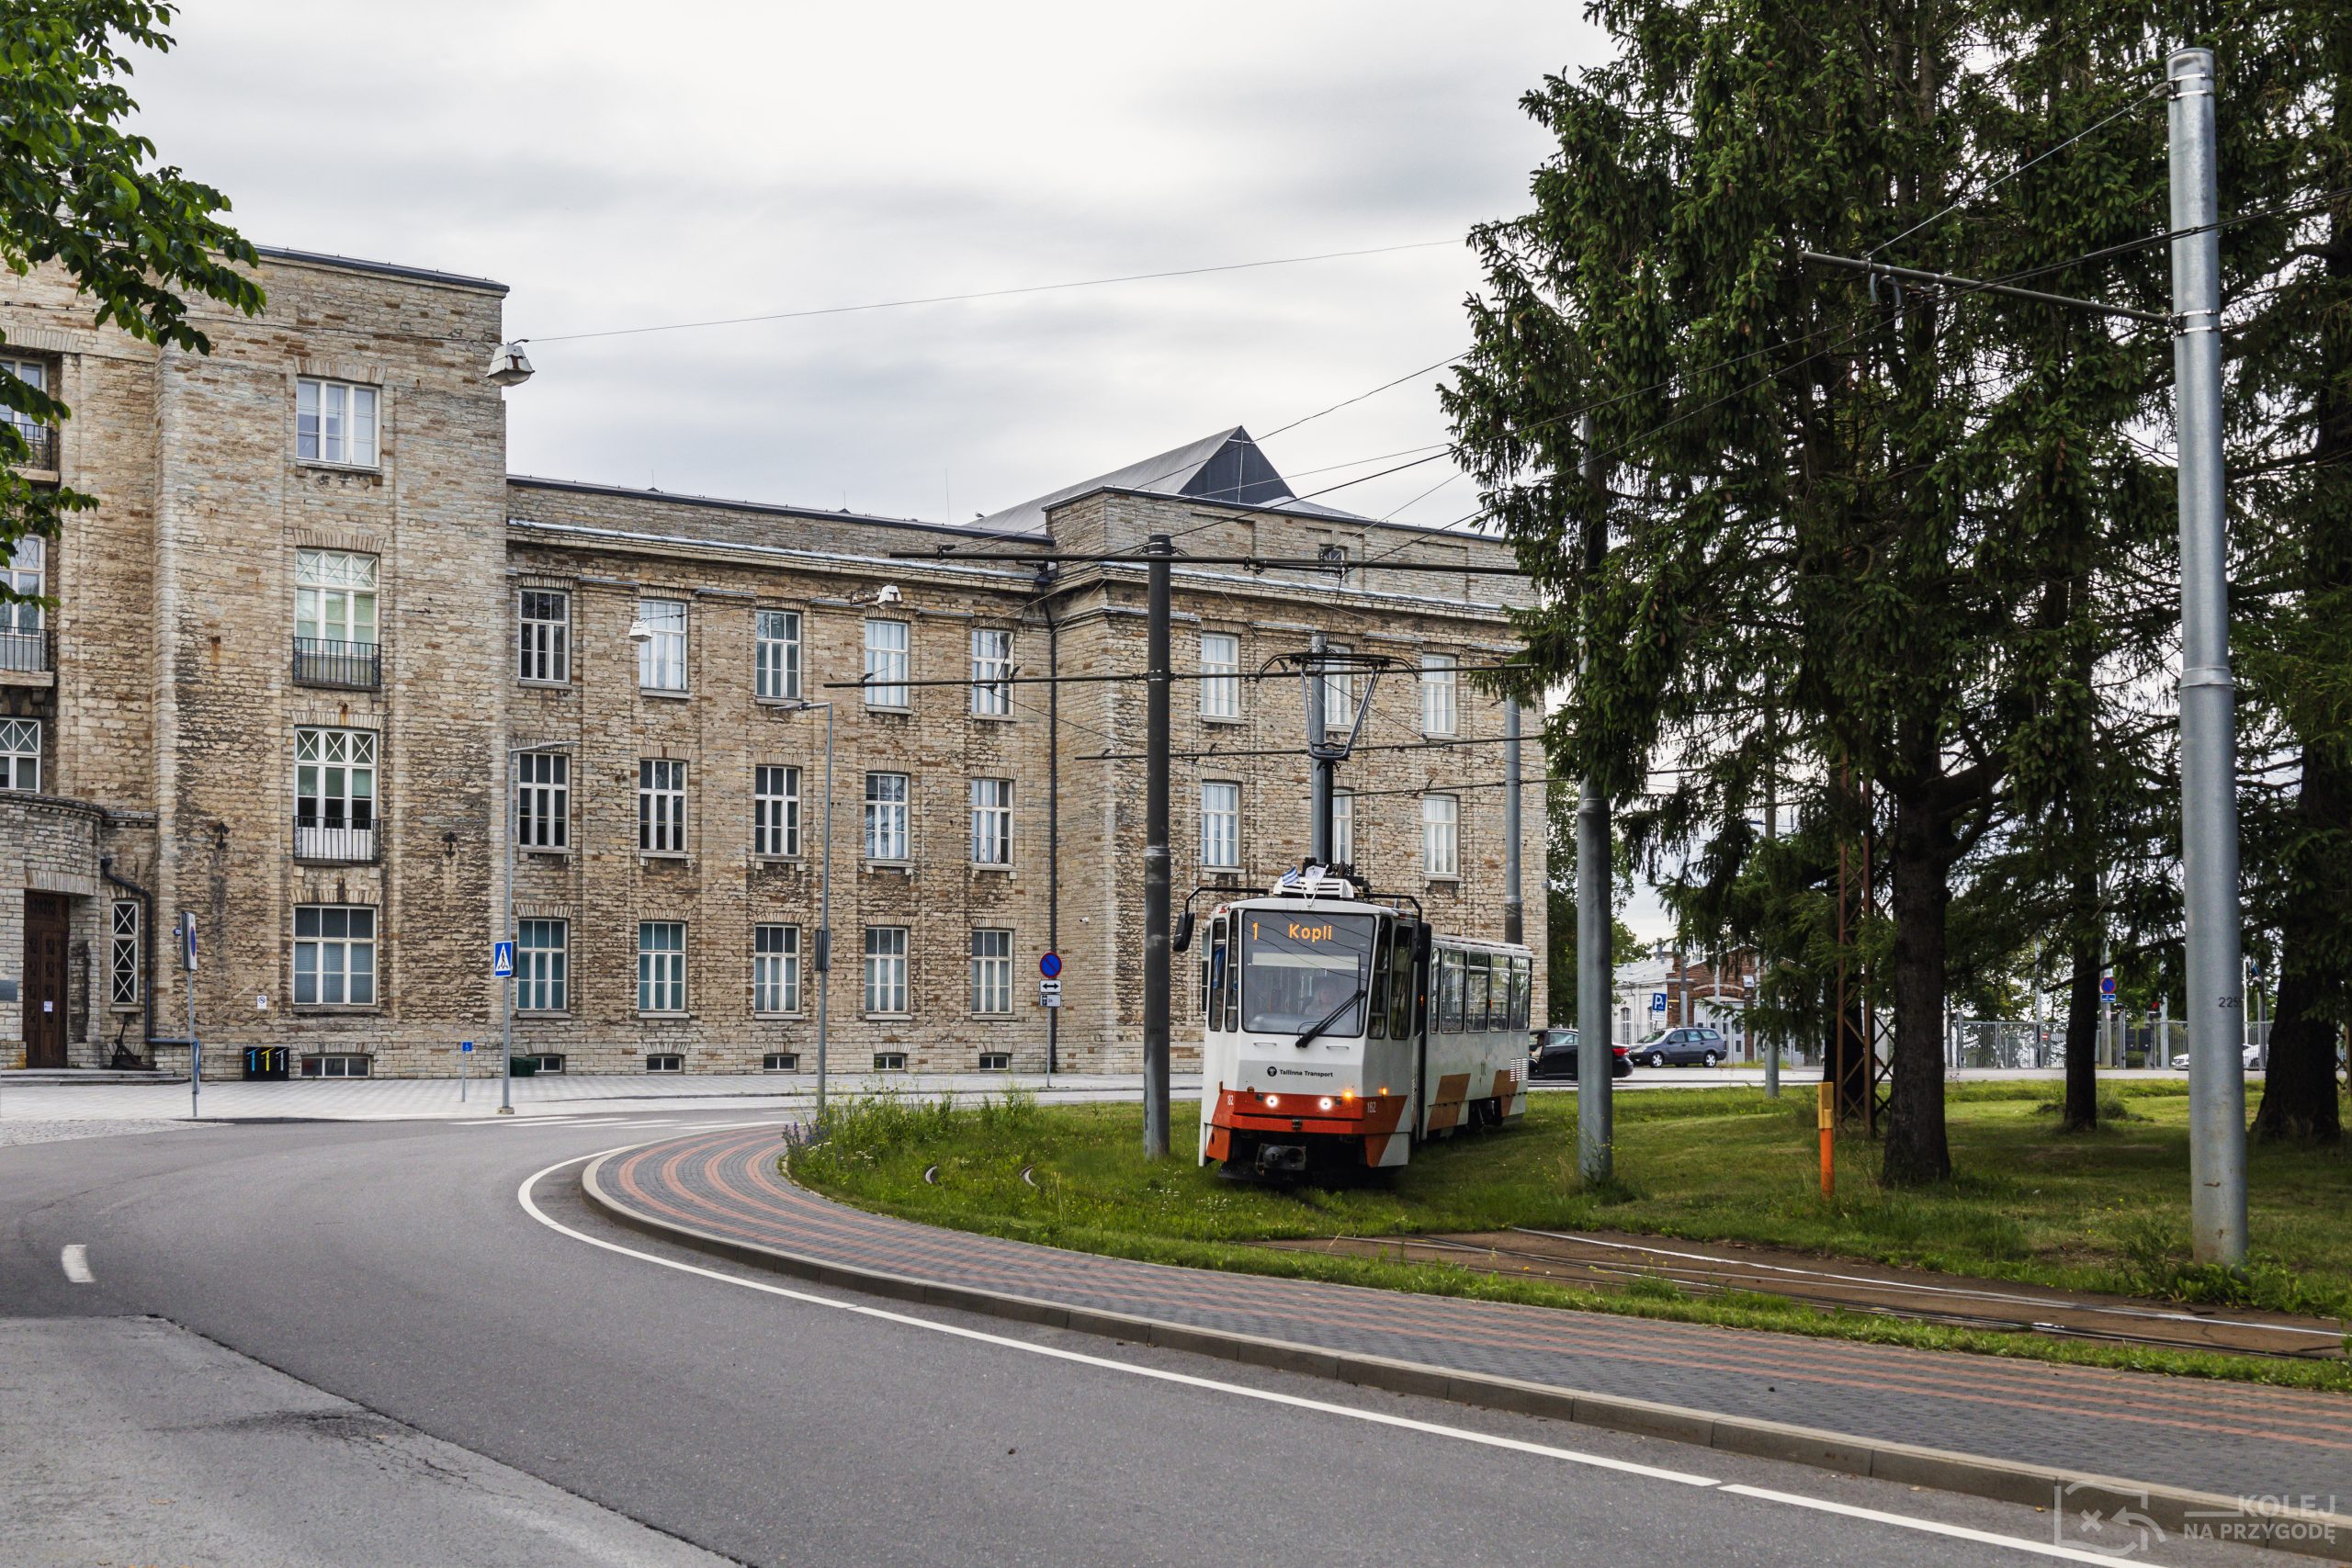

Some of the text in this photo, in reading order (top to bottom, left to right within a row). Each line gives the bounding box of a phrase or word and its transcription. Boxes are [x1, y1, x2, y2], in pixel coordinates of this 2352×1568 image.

[1252, 922, 1333, 942] 1 Kopli
[1367, 1101, 1376, 1113] 182
